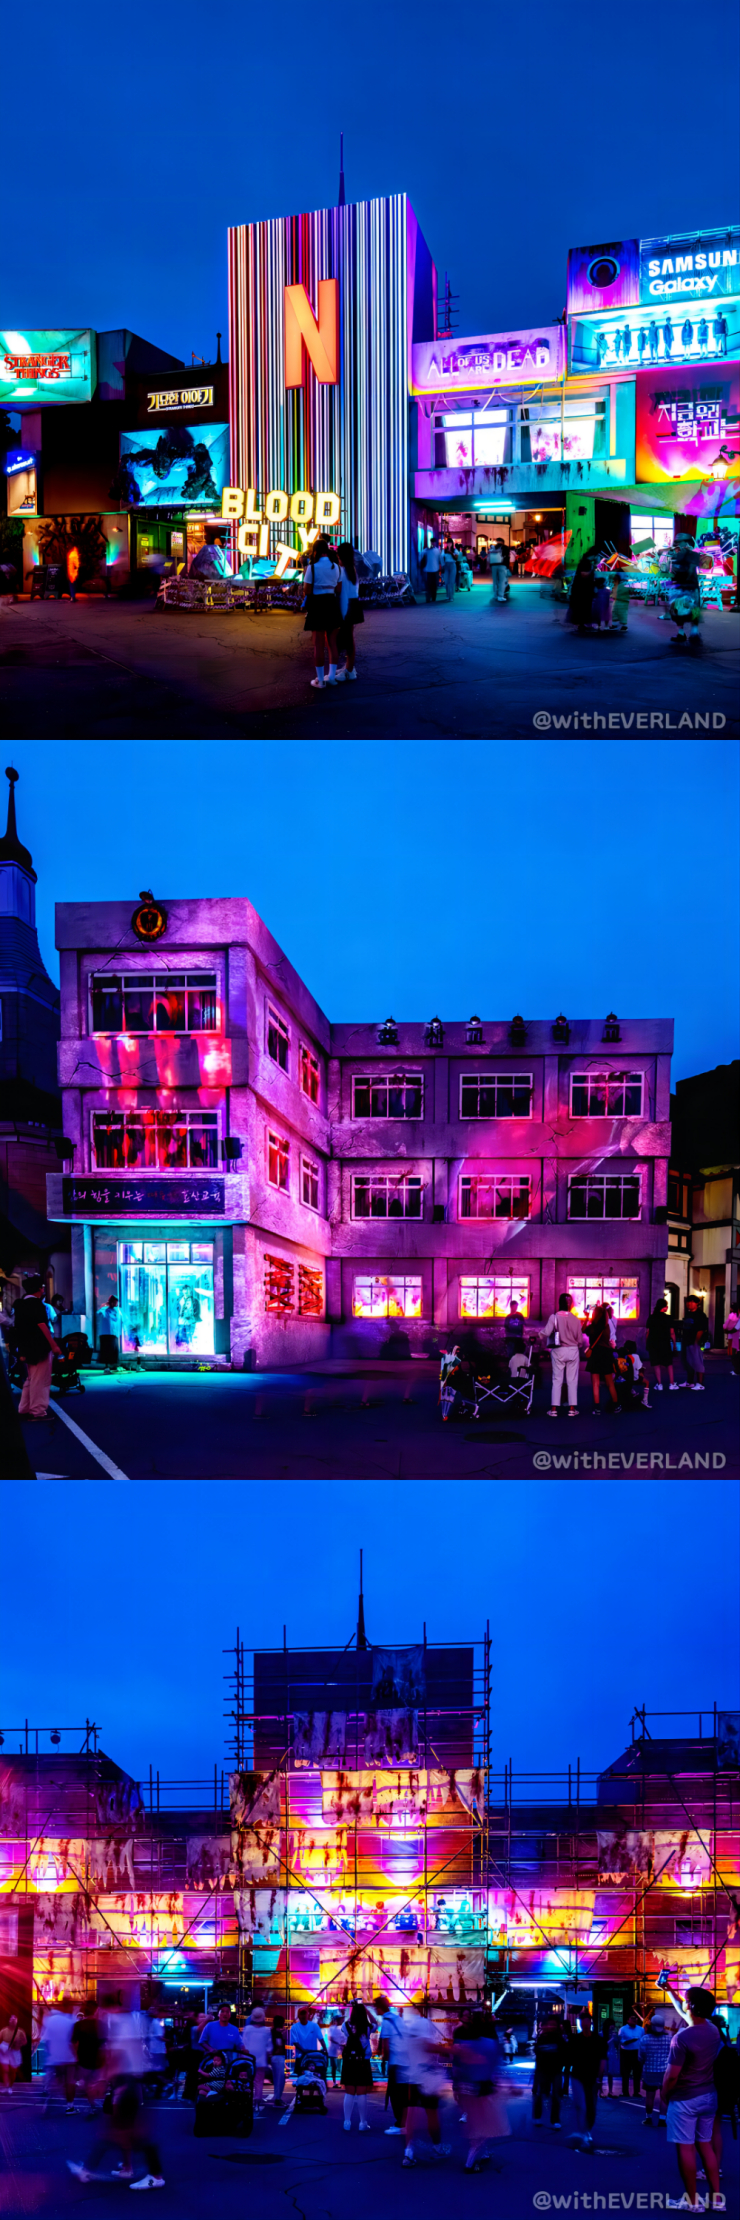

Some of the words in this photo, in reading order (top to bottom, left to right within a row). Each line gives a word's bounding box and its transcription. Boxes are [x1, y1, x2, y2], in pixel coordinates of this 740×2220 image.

[648, 249, 740, 277] SAMSUN
[649, 274, 718, 295] Galaxy
[284, 278, 339, 390] N
[4, 353, 70, 370] STRANGER
[427, 358, 460, 379] ALL
[458, 356, 471, 367] OF
[475, 355, 490, 366] US
[493, 346, 550, 373] DEAD
[14, 368, 60, 379] THINGS
[468, 365, 490, 376] ARE
[147, 392, 179, 410] 기묘한
[180, 388, 214, 405] 이야기
[657, 402, 694, 422] 지금
[696, 401, 721, 420] 우리
[222, 487, 341, 526] BLOOD
[237, 523, 320, 579] CITY
